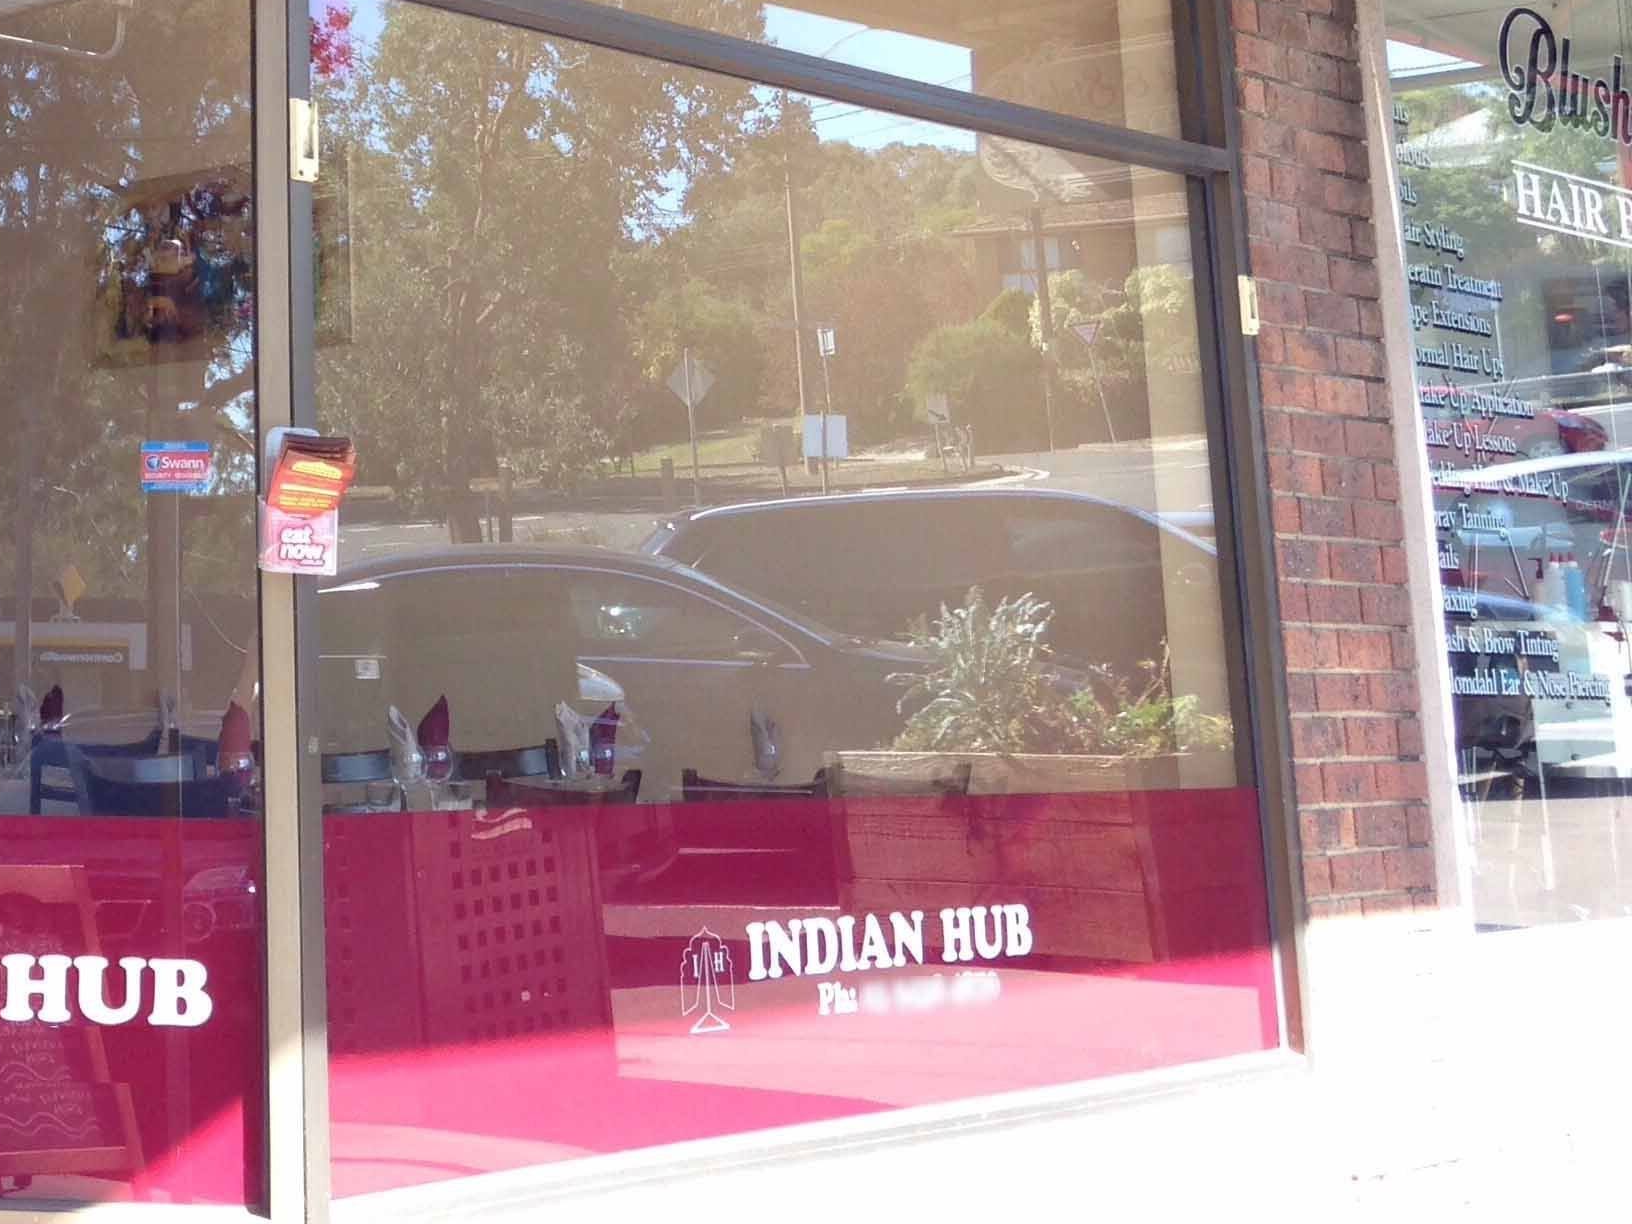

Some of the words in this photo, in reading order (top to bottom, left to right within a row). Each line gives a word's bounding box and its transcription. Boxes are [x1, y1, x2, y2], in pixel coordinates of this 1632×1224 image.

[1499, 8, 1632, 145] Blush
[1513, 170, 1608, 234] HAIR
[1423, 221, 1464, 260] Styling
[1408, 260, 1442, 286] eratin
[1444, 264, 1503, 299] Treatment
[1432, 301, 1491, 335] Extensions
[1416, 342, 1449, 366] ormal
[1451, 343, 1479, 371] Hair
[1481, 347, 1504, 381] Ups
[1419, 380, 1446, 406] ake
[1449, 382, 1467, 416] Up
[1471, 389, 1535, 419] Application
[1424, 420, 1449, 445] ake
[1453, 423, 1471, 455] Up
[1474, 424, 1516, 454] Lessons
[161, 456, 204, 471] Swann
[1550, 472, 1568, 503] Up
[1458, 503, 1506, 537] Tanning
[1438, 544, 1459, 569] ails
[1443, 588, 1478, 618] axing
[1446, 627, 1464, 652] ash
[1468, 629, 1480, 653] &
[1483, 629, 1515, 654] Brow
[1517, 630, 1560, 662] Tinting
[1450, 667, 1497, 695] lomdahl
[1500, 670, 1520, 695] Ear
[1524, 671, 1536, 696] &
[1537, 671, 1566, 699] Nose
[1568, 672, 1611, 704] Piercing
[745, 910, 925, 981] INDIAN
[940, 903, 1033, 963] HUB
[0, 955, 213, 1028] HUB
[817, 981, 858, 1016] Ph:
